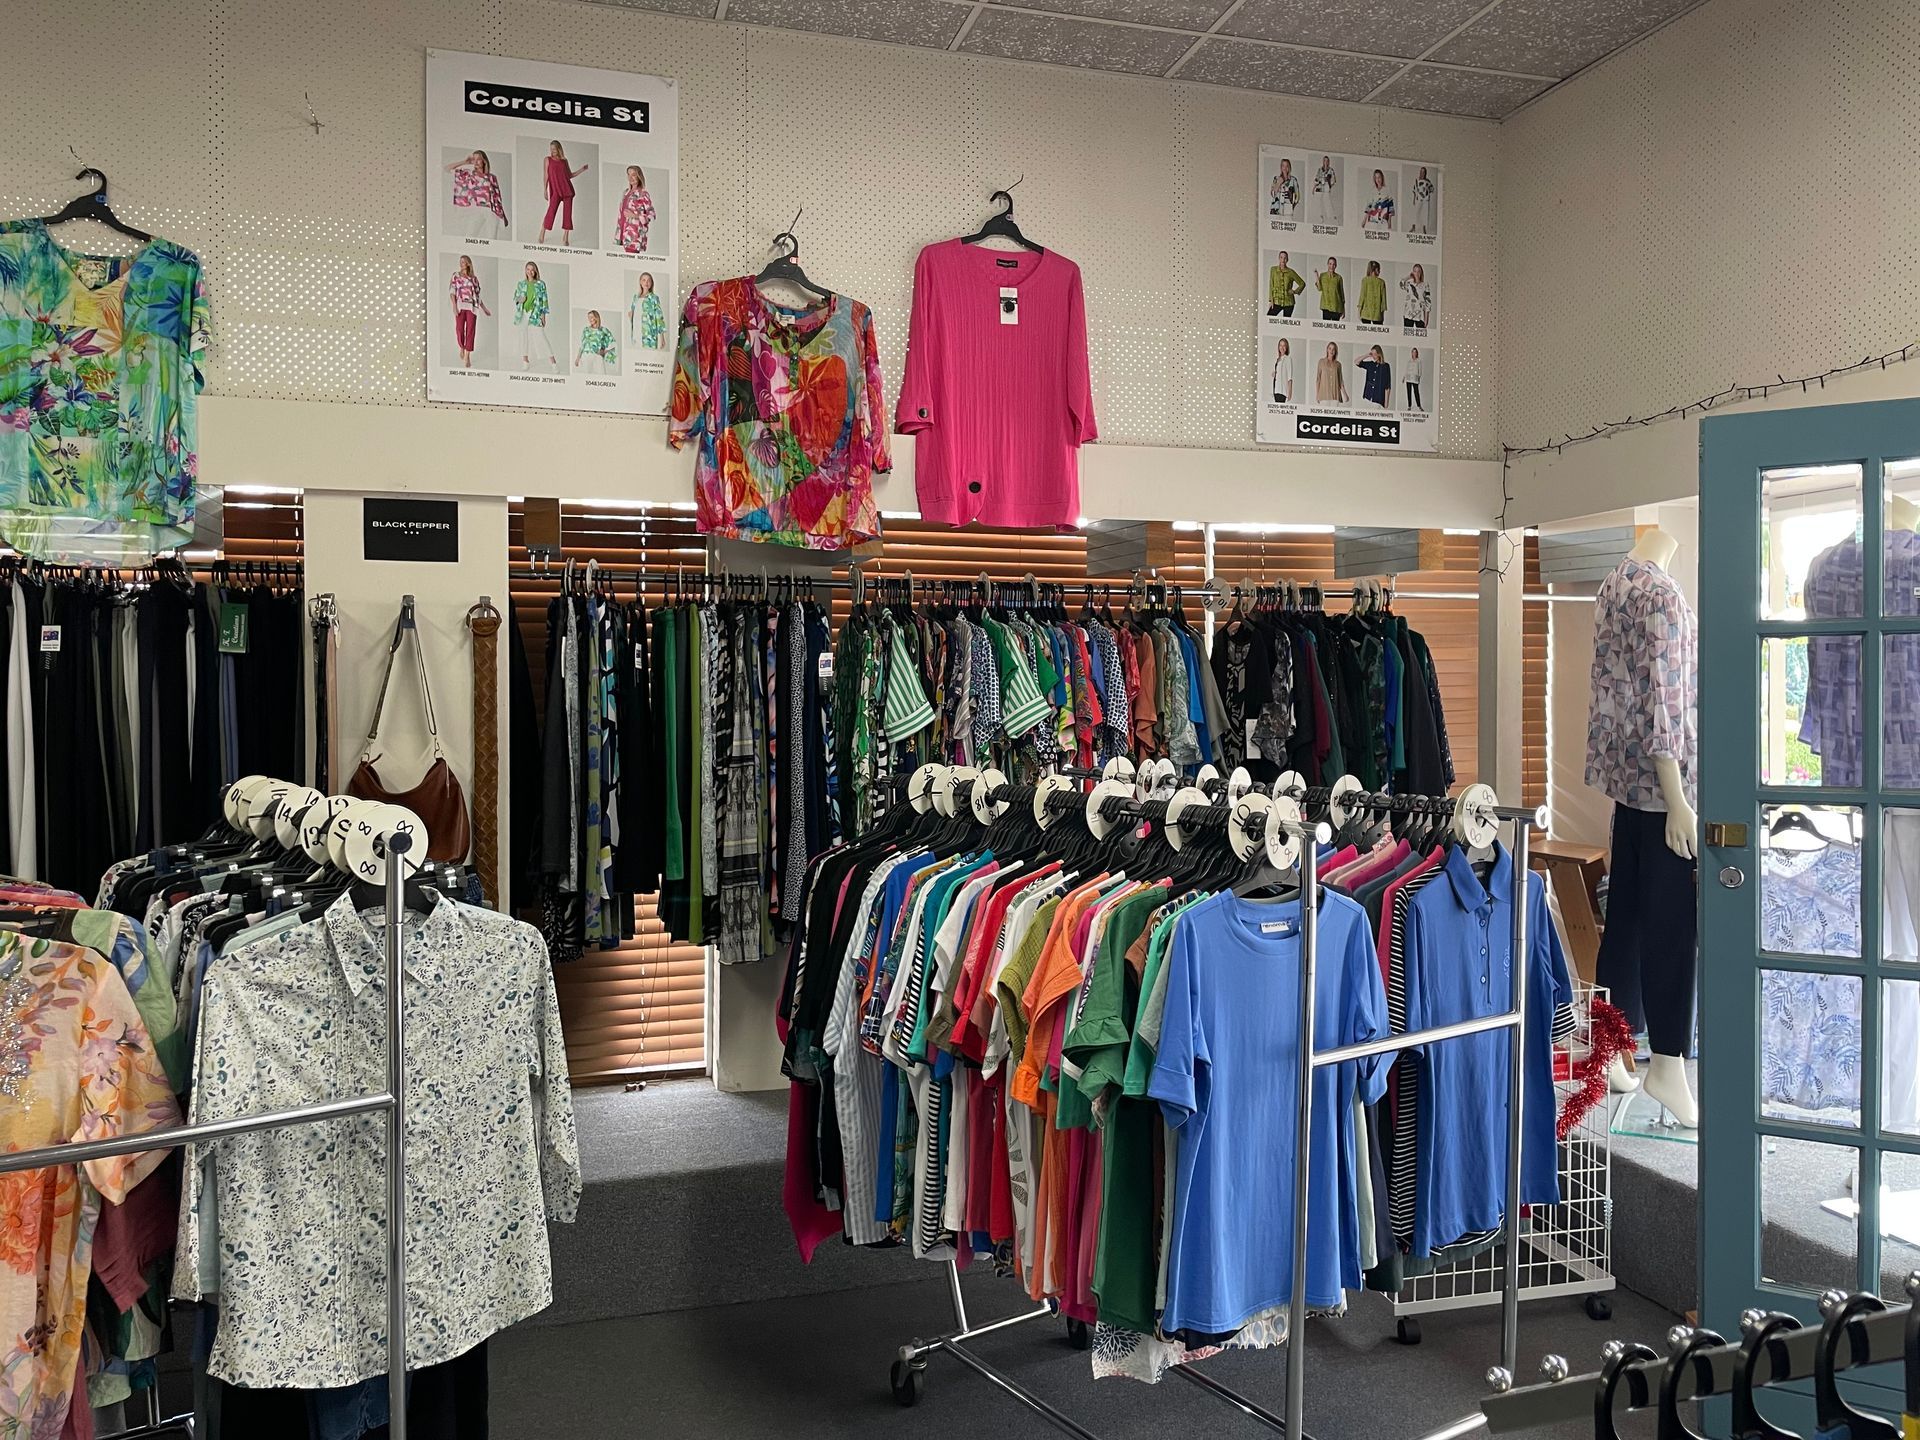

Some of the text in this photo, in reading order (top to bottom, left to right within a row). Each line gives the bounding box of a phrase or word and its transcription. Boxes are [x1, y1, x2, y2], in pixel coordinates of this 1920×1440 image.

[468, 89, 645, 125] Cordelia St
[1298, 420, 1398, 439] Cordelia St
[372, 520, 451, 530] BLACK PEPPER
[1203, 597, 1213, 609] 10
[1217, 598, 1228, 609] 10
[1482, 788, 1493, 804] 8
[278, 803, 292, 823] 14
[1232, 803, 1252, 827] 10
[358, 821, 372, 836] 8
[396, 820, 414, 835] 8
[1469, 827, 1482, 843] 8
[303, 826, 325, 849] 12
[1269, 836, 1279, 854] 8
[1284, 848, 1293, 862] 8
[360, 860, 377, 876] 8
